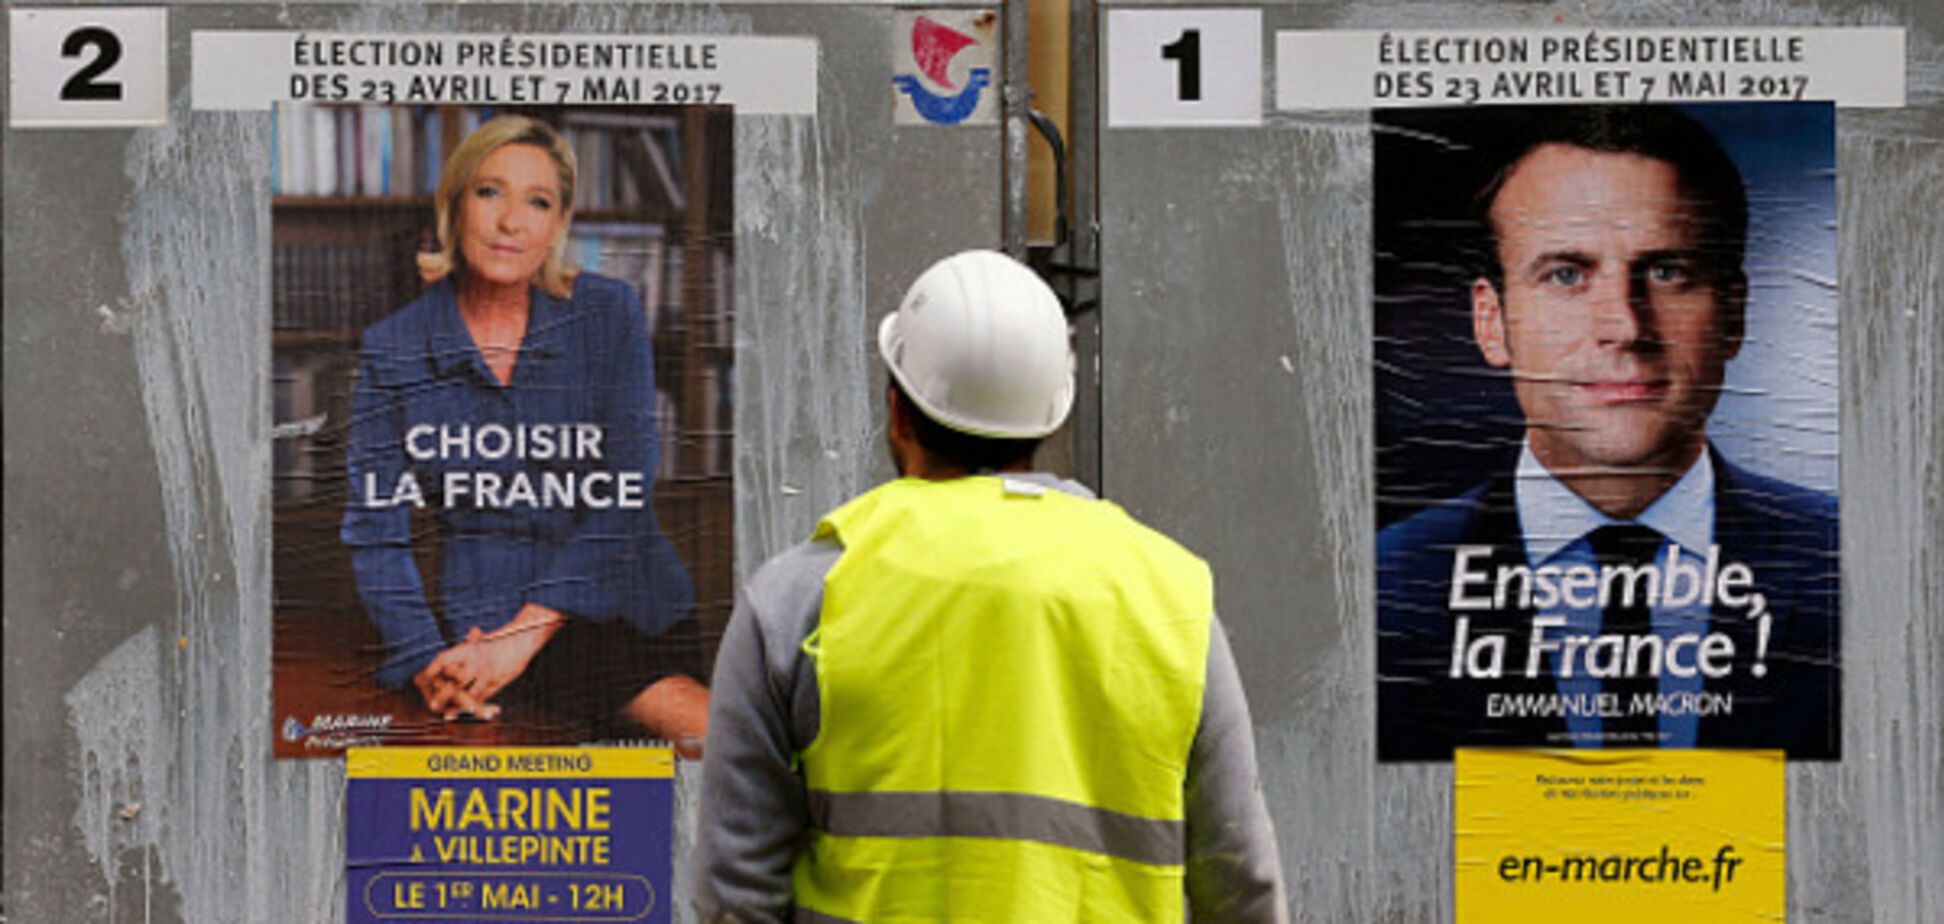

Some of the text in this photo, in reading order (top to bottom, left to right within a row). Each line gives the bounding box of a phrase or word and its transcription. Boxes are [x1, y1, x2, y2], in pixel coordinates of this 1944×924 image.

[60, 26, 124, 101] 2
[293, 34, 718, 69] ÉLECTION PRÉSIDENTIELLE
[1379, 30, 1805, 63] ÉLECTION PRÉSIDENTIELLE
[1162, 29, 1201, 101] 1
[290, 73, 722, 104] DES 23 AVRIL ET 7 MAI 2017
[1374, 71, 1809, 104] DES 23 AVRIL ET 7 MAI 2017
[404, 423, 604, 460] CHOISIR
[365, 471, 644, 509] LA FRANCE
[1449, 544, 1768, 619] Ensemble,
[1449, 616, 1507, 678] la
[1525, 615, 1736, 678] France
[1487, 691, 1733, 718] EMMANUEL MACRON
[427, 753, 592, 773] GRAND MEETING
[410, 787, 611, 831] MARINE
[433, 834, 610, 865] VILLEPINTE
[1498, 845, 1743, 894] en-marche.fr
[394, 881, 425, 909] LE
[482, 882, 540, 910] MAI
[568, 883, 624, 910] 12H
